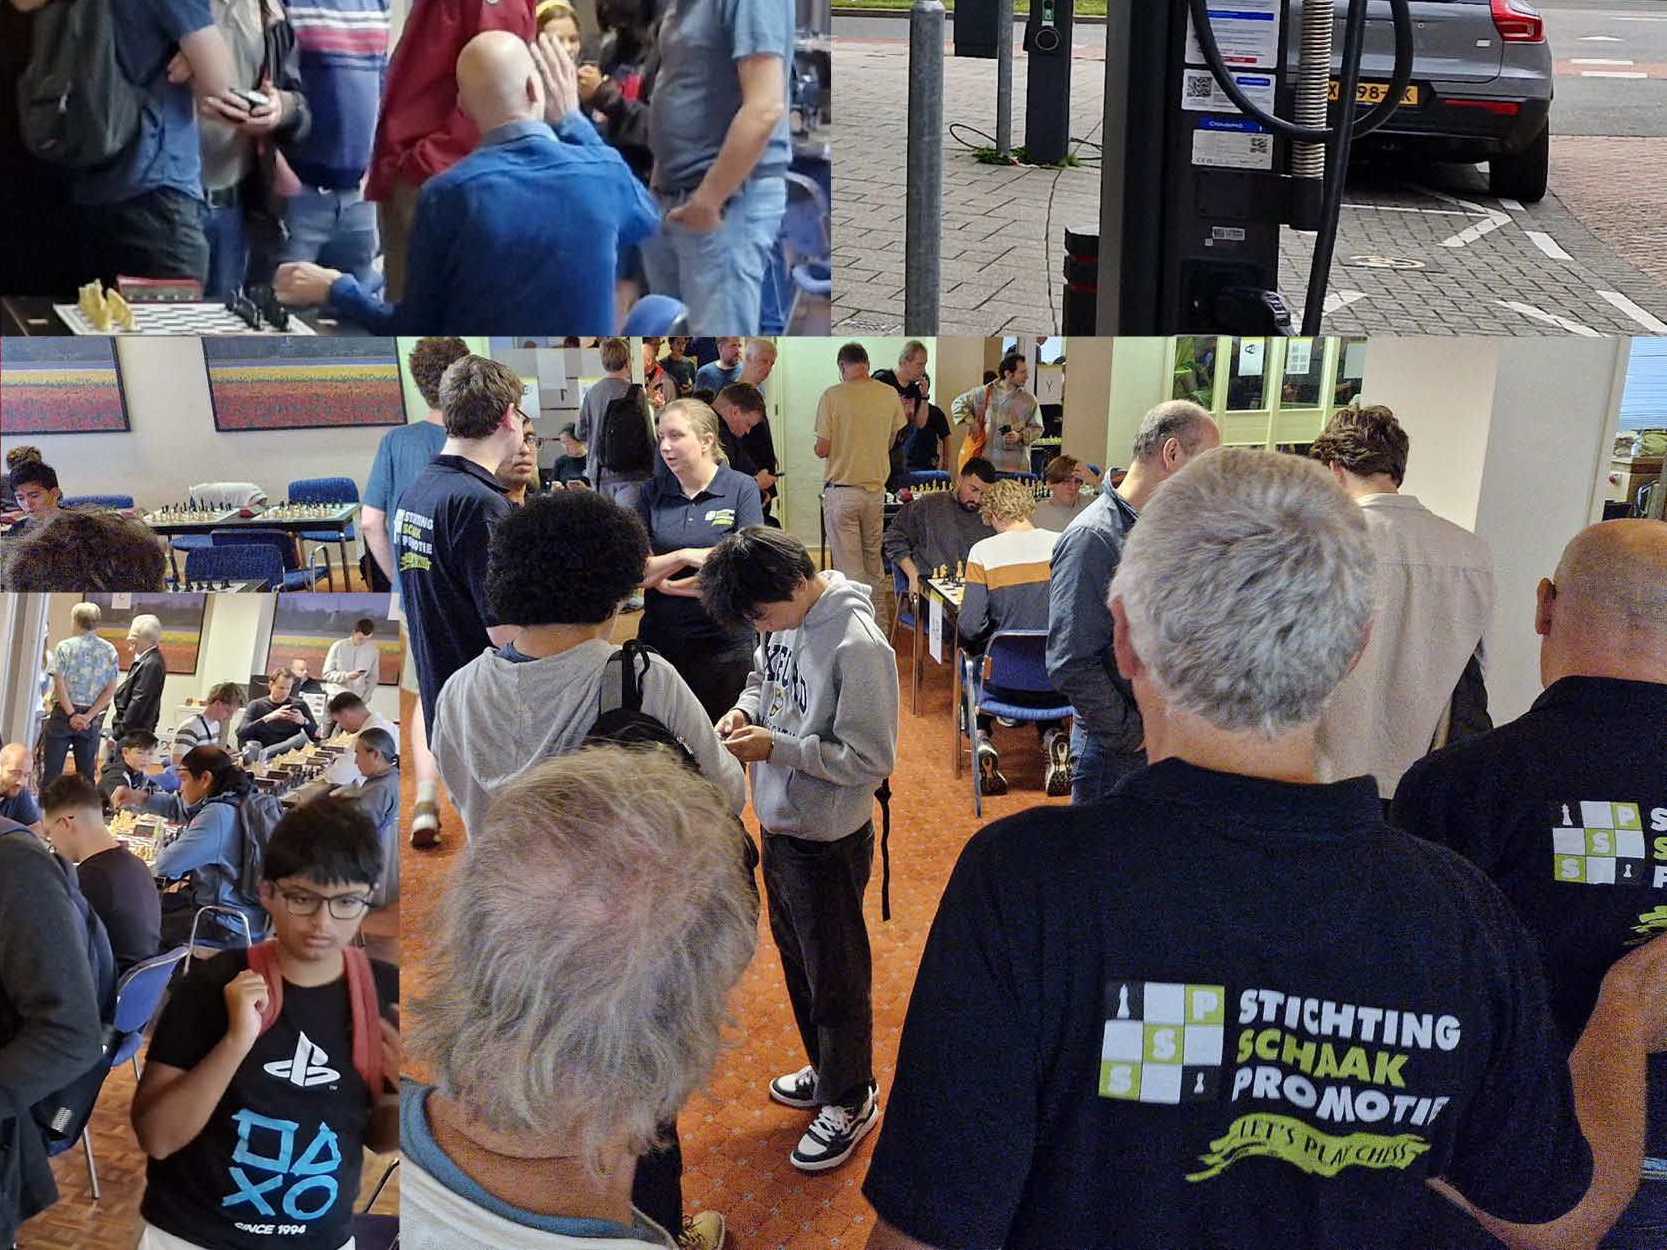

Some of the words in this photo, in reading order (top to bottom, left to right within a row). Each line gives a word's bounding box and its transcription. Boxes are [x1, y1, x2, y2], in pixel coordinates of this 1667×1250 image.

[1045, 379, 1054, 394] Y
[1238, 988, 1462, 1051] STICHTING
[1236, 1028, 1409, 1089] SCHAAK
[234, 1222, 275, 1235] SINCE
[277, 1224, 307, 1235] 1994
